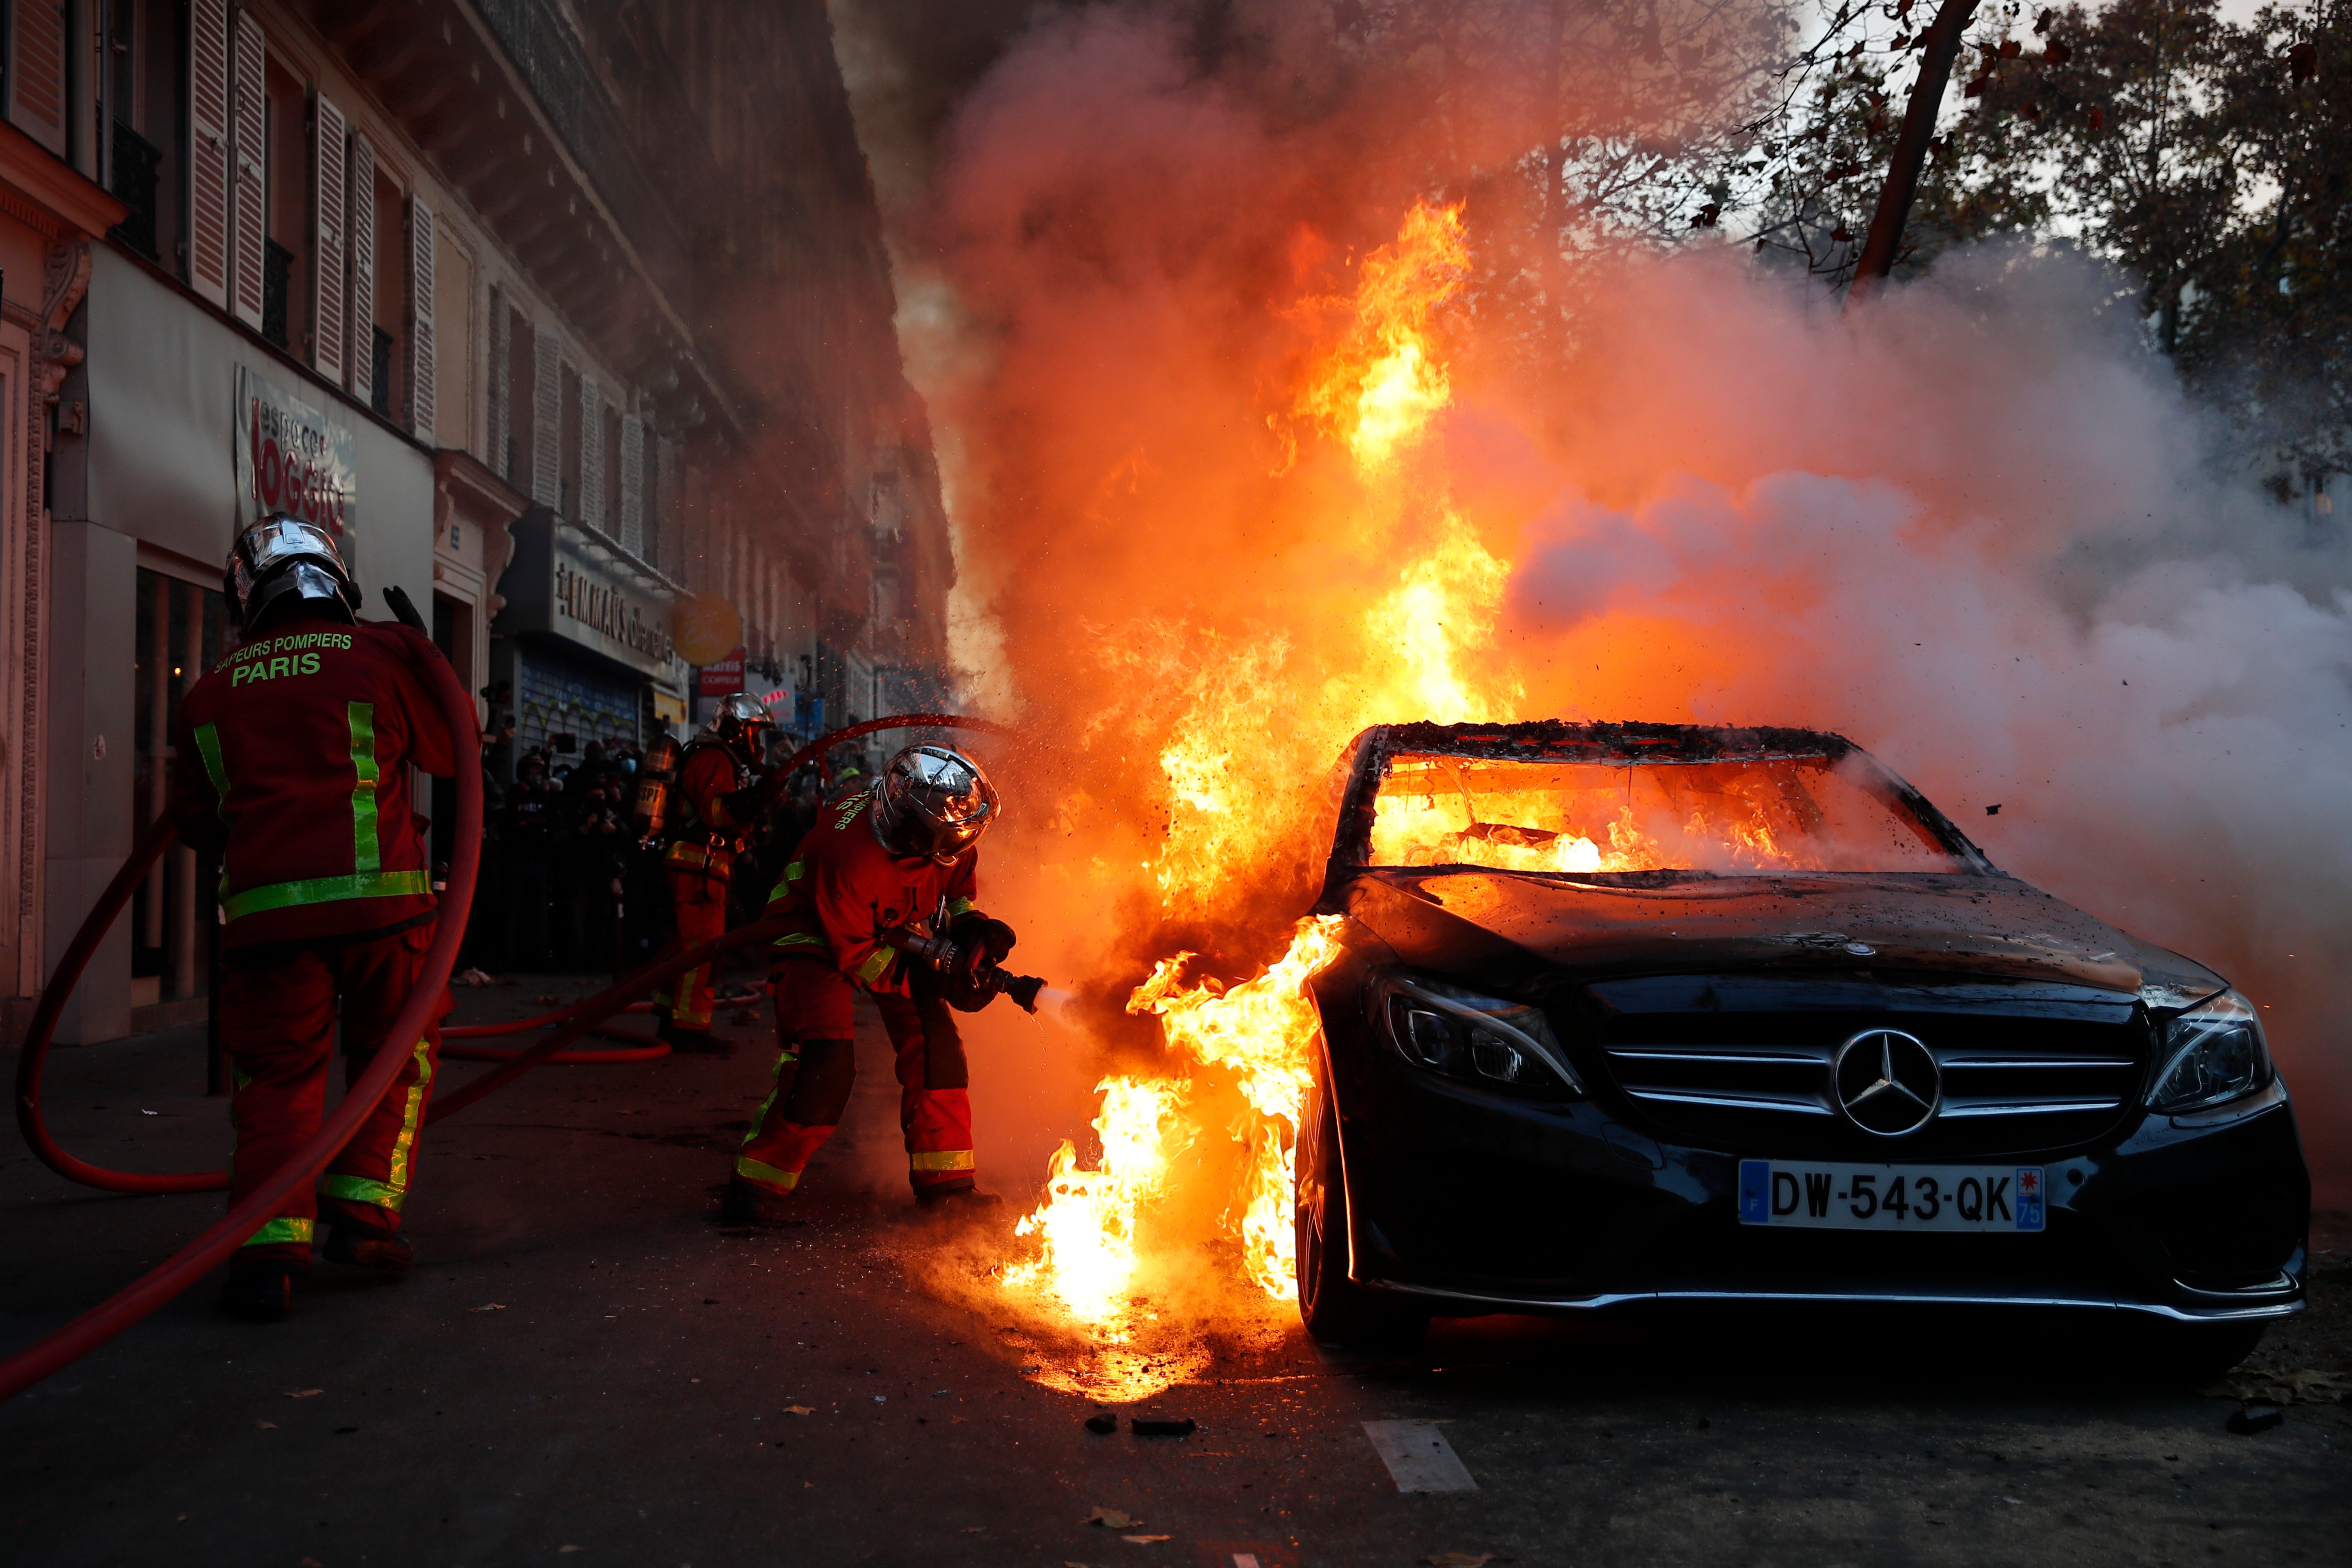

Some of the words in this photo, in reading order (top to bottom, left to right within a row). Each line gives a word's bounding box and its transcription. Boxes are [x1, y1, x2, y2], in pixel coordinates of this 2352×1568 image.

[214, 640, 271, 674] SAPEURS
[274, 633, 352, 650] POMPIERS
[232, 652, 321, 688] PARIS
[1750, 1198, 1758, 1211] F
[1772, 1171, 2012, 1222] DW-543-QK
[2019, 1203, 2040, 1224] 75
